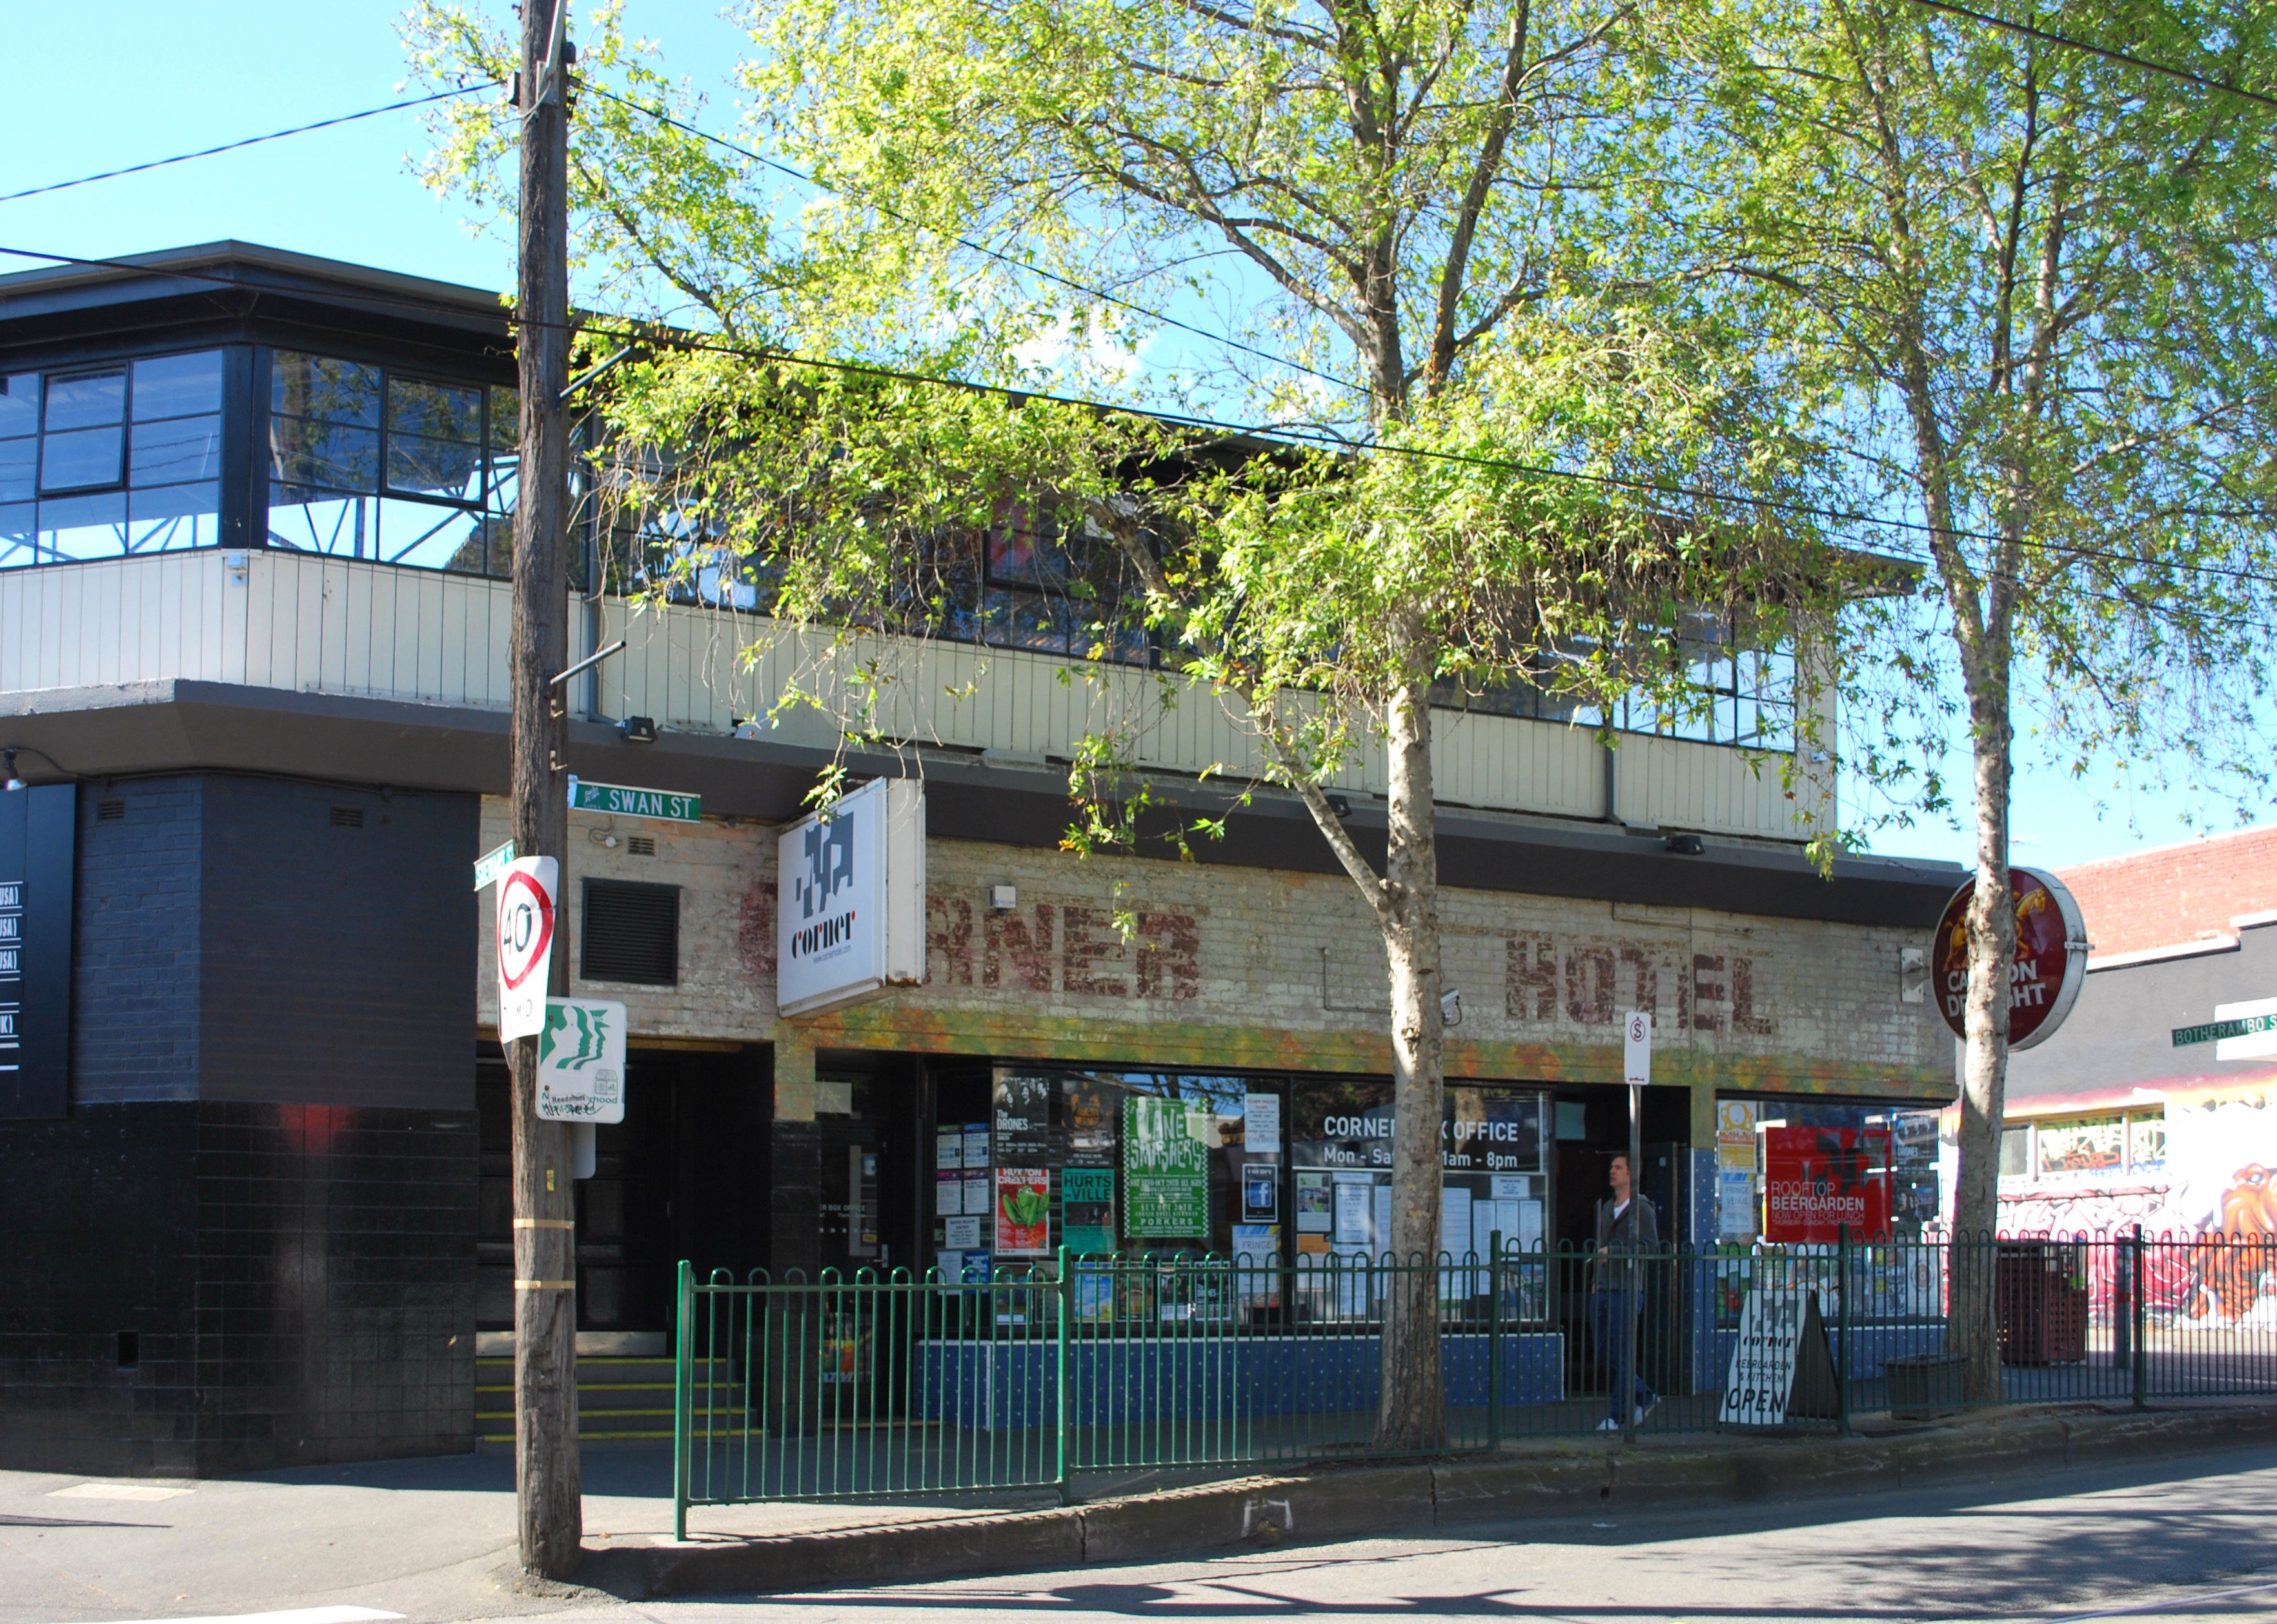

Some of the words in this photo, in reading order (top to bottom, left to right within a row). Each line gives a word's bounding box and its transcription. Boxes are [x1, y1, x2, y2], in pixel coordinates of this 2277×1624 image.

[609, 789, 662, 816] SWAN
[670, 796, 692, 818] ST
[503, 903, 532, 955] 40
[791, 910, 856, 959] corner
[2175, 1017, 2265, 1045] BOTHERAMBO
[997, 1118, 1029, 1130] DRONES
[1453, 1121, 1519, 1142] OFFICE
[1130, 1139, 1201, 1173] SMASHERS
[1324, 1146, 1355, 1162] Mon
[1486, 1151, 1517, 1171] 8pm
[1064, 1175, 1112, 1188] HURTS
[1771, 1181, 1836, 1197] ROOFTOP
[1064, 1189, 1112, 1201] -VILLE
[1771, 1196, 1865, 1211] BEERGARDEN
[1140, 1217, 1193, 1226] PORKERS
[1771, 1210, 1792, 1220] NOW
[1794, 1210, 1817, 1220] OPEN
[1818, 1210, 1836, 1220] FOR
[1836, 1211, 1865, 1220] LUNCH
[1242, 1241, 1271, 1250] FRINGE
[1735, 1359, 1792, 1370] BEERGARDEN
[1728, 1388, 1785, 1413] OPEN
